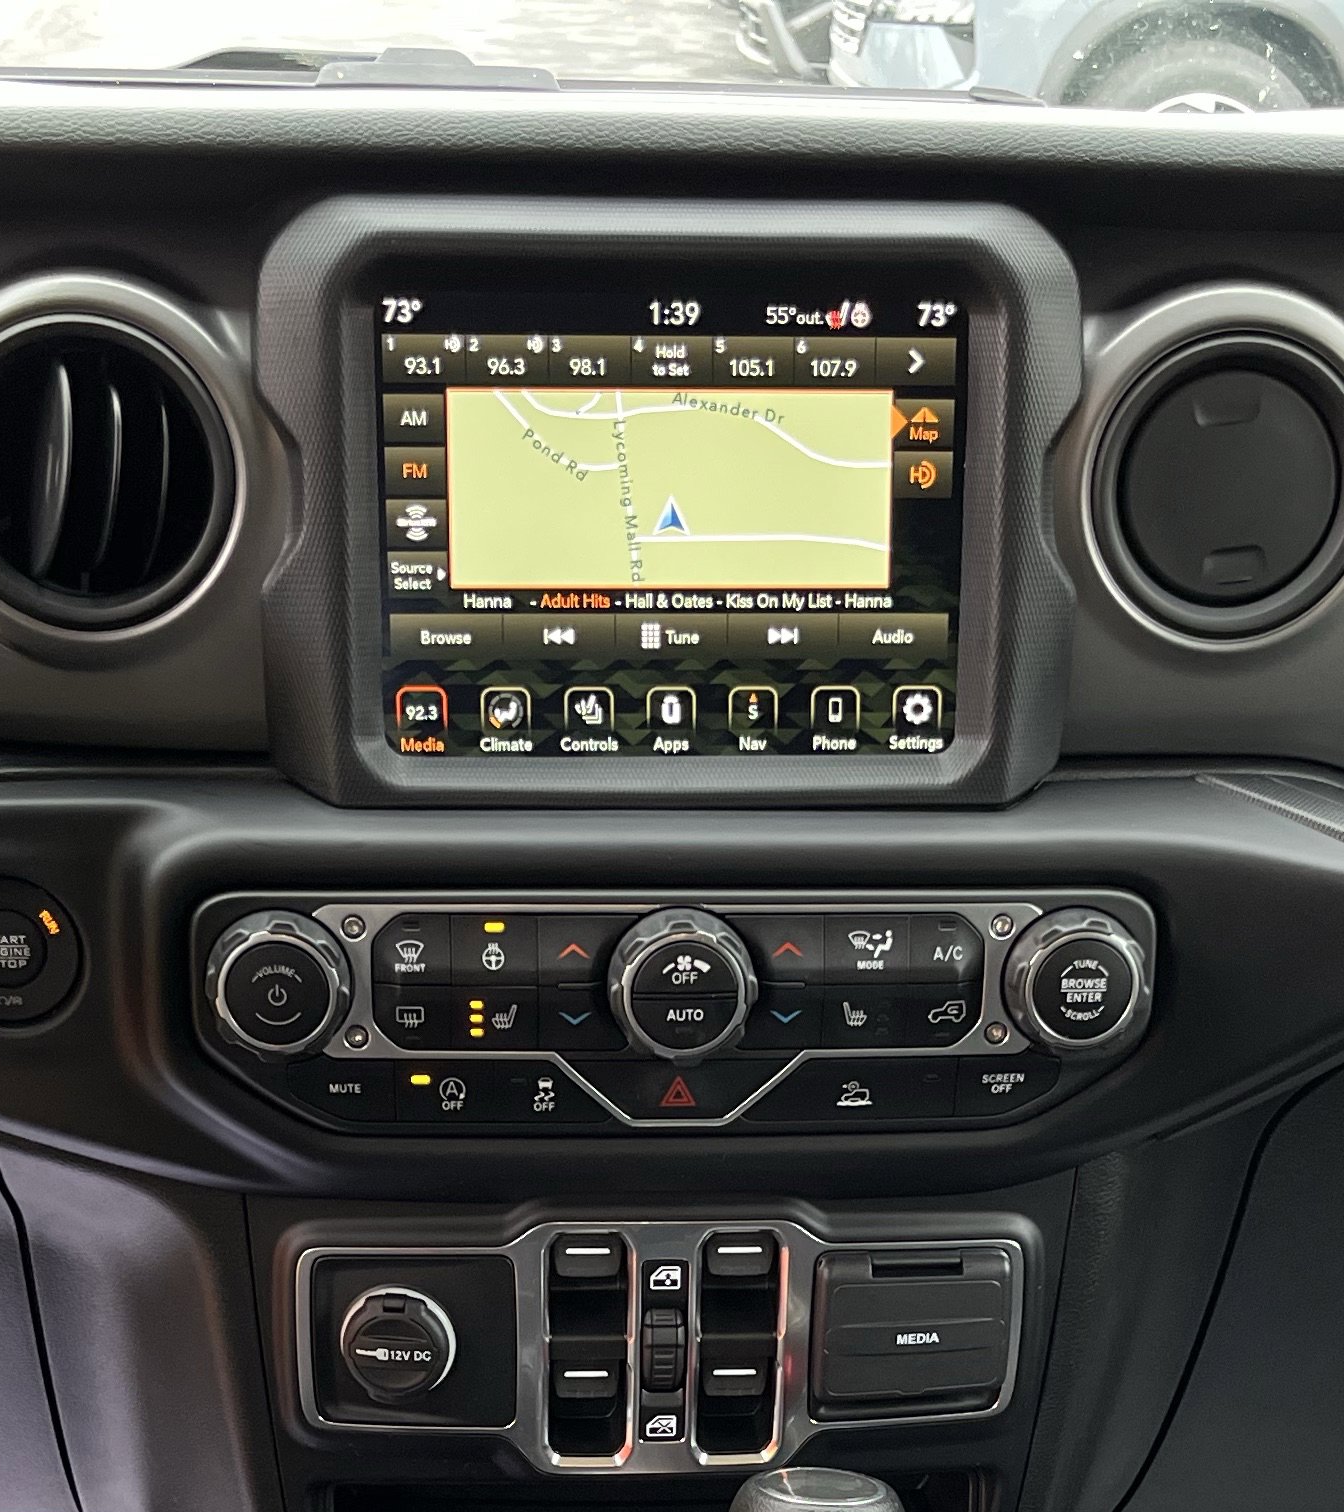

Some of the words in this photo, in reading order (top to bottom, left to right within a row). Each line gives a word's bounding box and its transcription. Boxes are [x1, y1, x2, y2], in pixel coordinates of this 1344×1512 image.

[649, 301, 700, 326] 1:39
[386, 337, 395, 351] 1
[469, 337, 480, 352] 2
[551, 338, 561, 352] 3
[634, 338, 644, 353] 4
[715, 339, 725, 354] 5
[797, 340, 807, 354] 6
[656, 345, 686, 359] Hold
[404, 357, 442, 376] 93.1
[487, 358, 526, 376] 96.3
[569, 358, 607, 376] 98.1
[652, 364, 666, 377] to
[668, 363, 690, 377] Set
[729, 359, 775, 377] 105.1
[810, 359, 857, 378] 107.9
[672, 392, 758, 420] Alexander
[764, 408, 785, 425] Dr
[400, 410, 427, 426] AM
[909, 427, 939, 444] Map
[522, 428, 564, 465] Pond
[566, 460, 589, 482] Rd
[402, 463, 428, 479] FM
[612, 420, 633, 507] Lycoming
[624, 515, 642, 552] Mall
[391, 562, 433, 575] Source
[630, 559, 646, 583] Rd
[394, 577, 432, 591] Select
[463, 592, 512, 609] Hanna
[540, 592, 579, 609] Adult
[582, 592, 611, 609] Hits
[625, 593, 653, 609] Hall
[656, 593, 669, 609] &
[672, 593, 713, 609] Oates
[726, 593, 753, 609] Kiss
[757, 593, 779, 609] On
[782, 593, 805, 613] My
[808, 593, 832, 609] List
[844, 593, 893, 609] Hanna
[420, 630, 472, 646] Browse
[665, 629, 700, 645] Tune
[872, 629, 914, 645] Audio
[406, 705, 438, 721] 92.3
[400, 737, 445, 752] Media
[480, 737, 533, 752] Climate
[560, 737, 618, 752] Controls
[653, 736, 689, 755] Apps
[739, 736, 767, 751] Nav
[812, 736, 856, 751] Phone
[889, 735, 943, 753] Settings
[933, 945, 963, 961] A/C
[256, 965, 296, 978] VOLUME
[395, 964, 426, 973] FRONT
[857, 960, 884, 970] MODE
[1073, 959, 1099, 970] TUNE
[671, 971, 699, 985] OFF
[1061, 978, 1107, 989] BROWSE
[1066, 992, 1102, 1003] ENTER
[666, 1009, 704, 1022] AUTO
[1064, 1007, 1099, 1021] SCROLL
[982, 1073, 1025, 1084] SCREEN
[329, 1084, 361, 1095] MUTE
[991, 1084, 1012, 1094] OFF
[441, 1100, 464, 1111] OFF
[533, 1101, 555, 1112] OFF
[896, 1332, 940, 1345] MEDIA
[390, 1350, 411, 1361] 12V
[413, 1350, 432, 1362] DC
